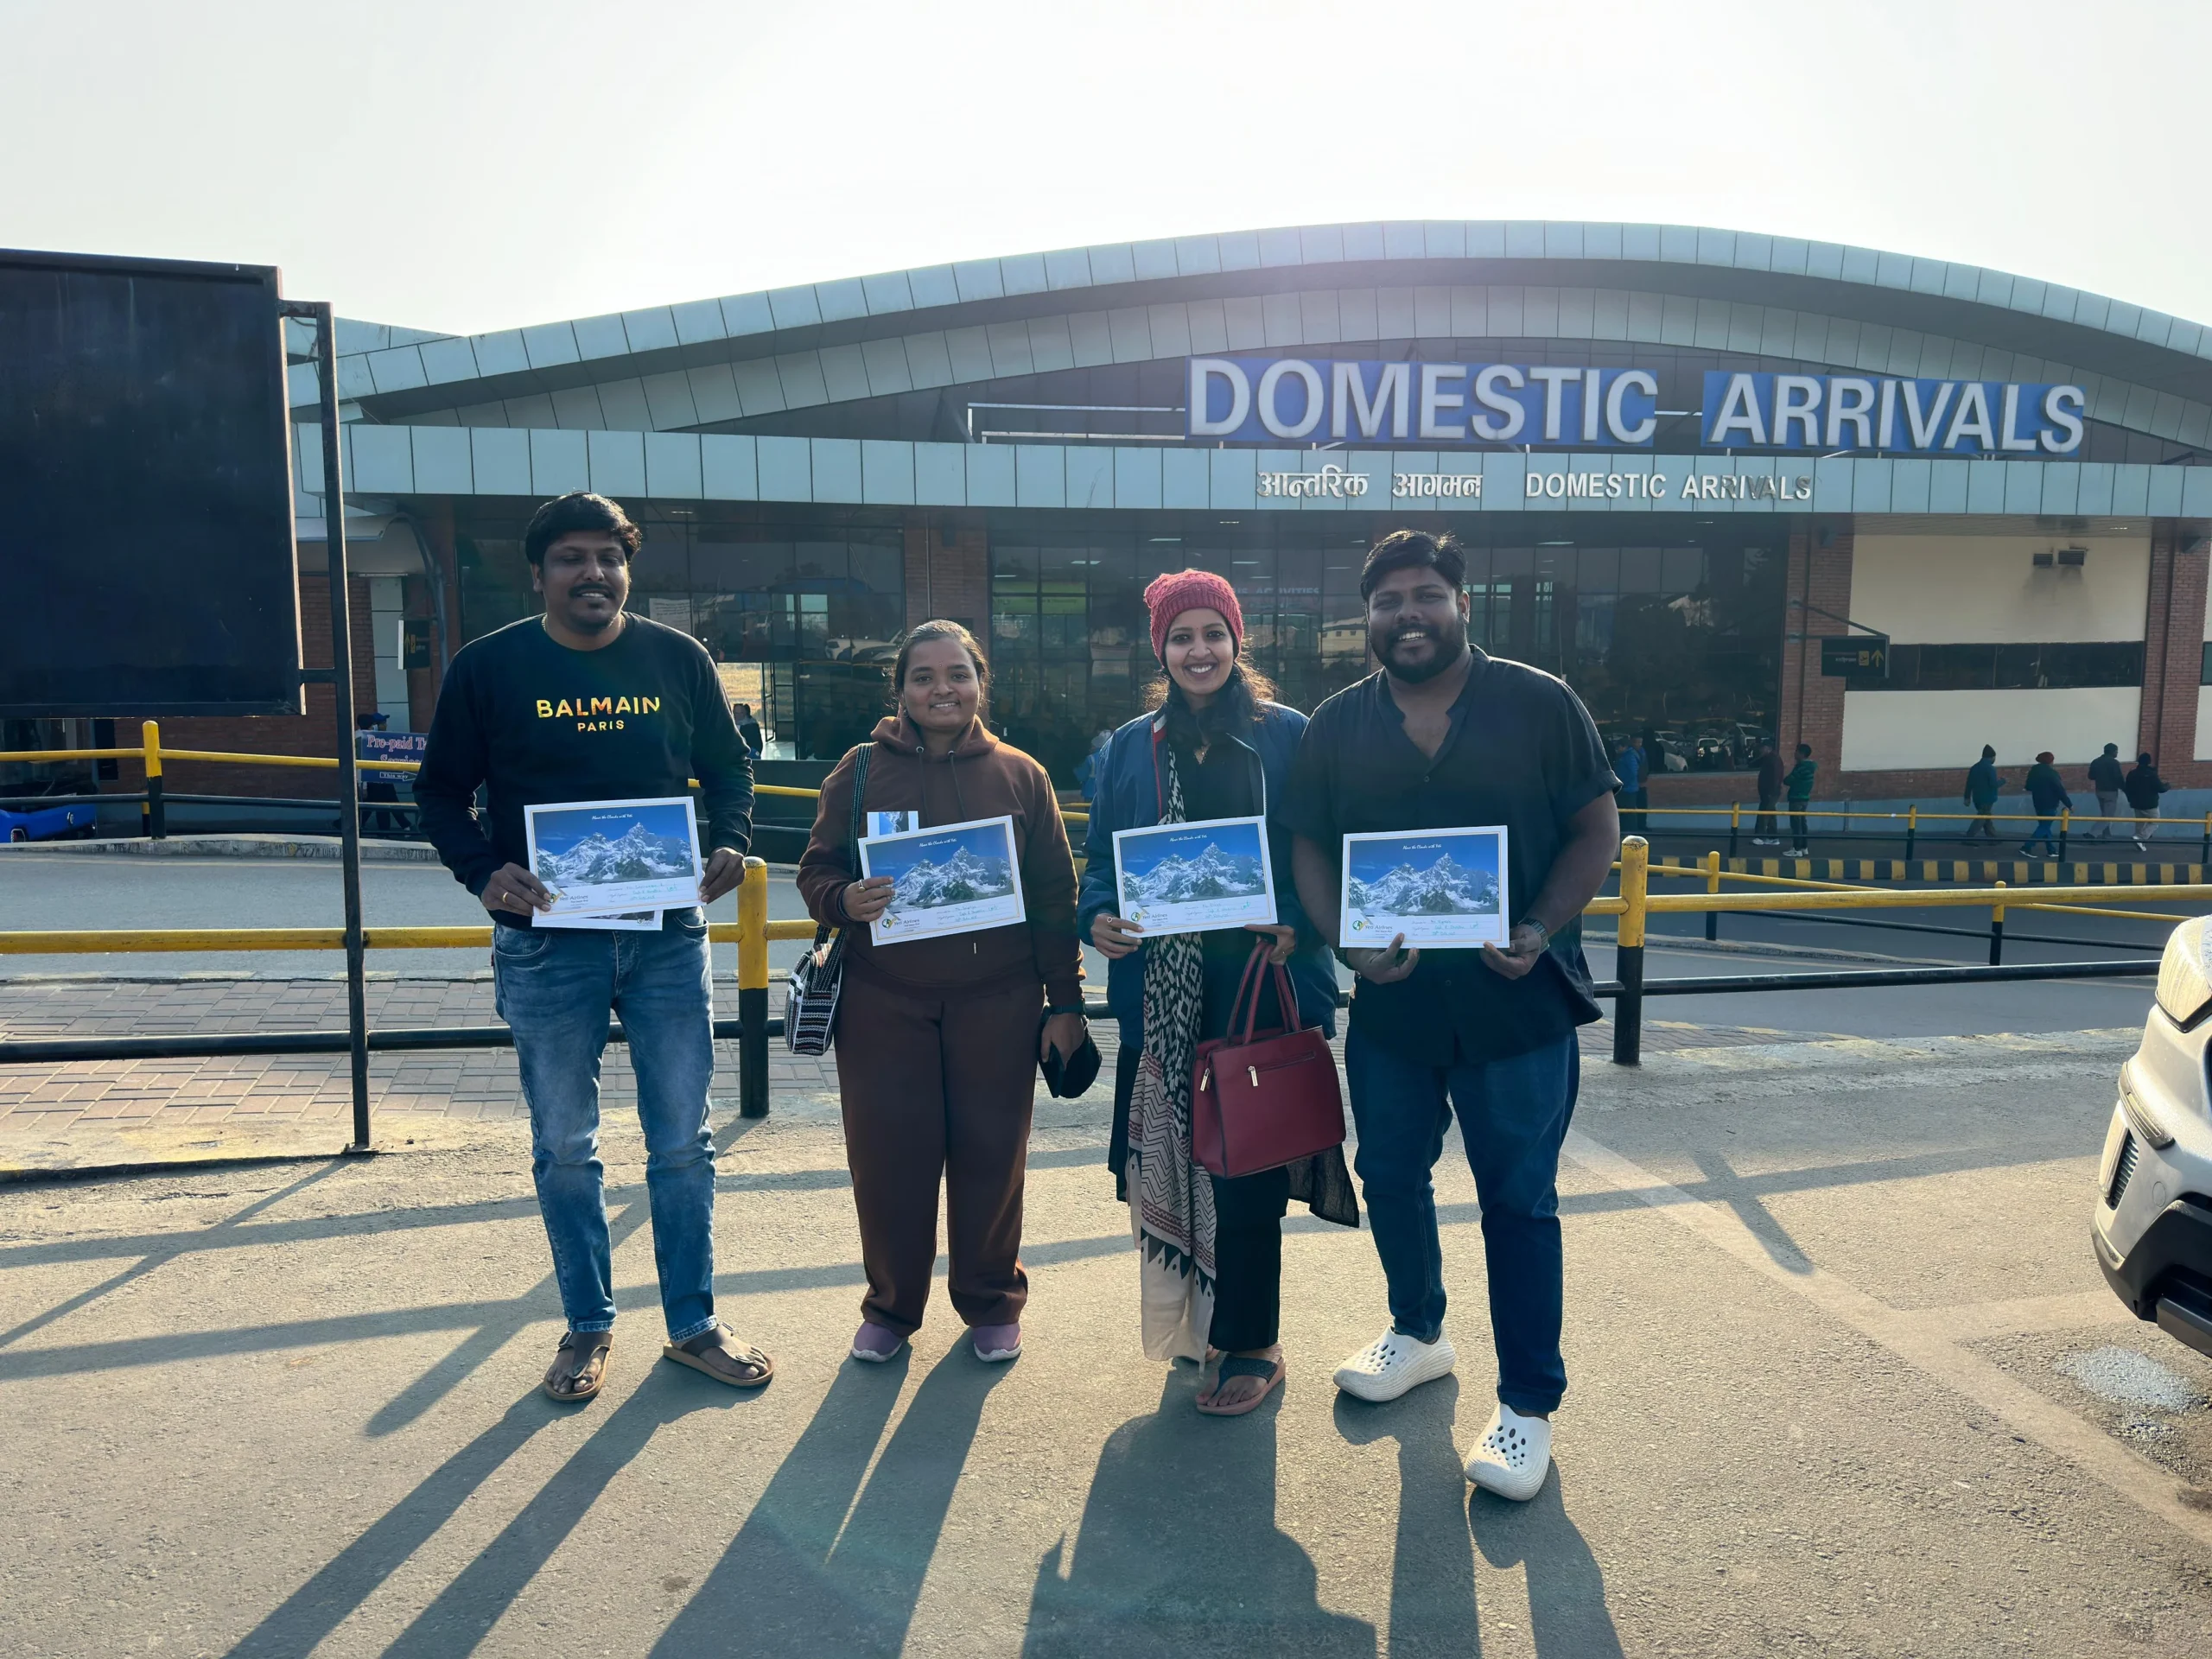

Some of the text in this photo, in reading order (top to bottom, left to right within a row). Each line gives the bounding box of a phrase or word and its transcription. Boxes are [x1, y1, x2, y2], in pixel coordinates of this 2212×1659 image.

[1189, 359, 2086, 454] DOMESTIC ARRIVALS
[1256, 464, 1484, 499] आन्तरिक आगमन
[1526, 473, 1812, 500] DOMESTIC ARRIVALS
[536, 696, 660, 718] BALMAIN
[577, 720, 625, 732] PARIS
[366, 734, 413, 752] Pre-paid
